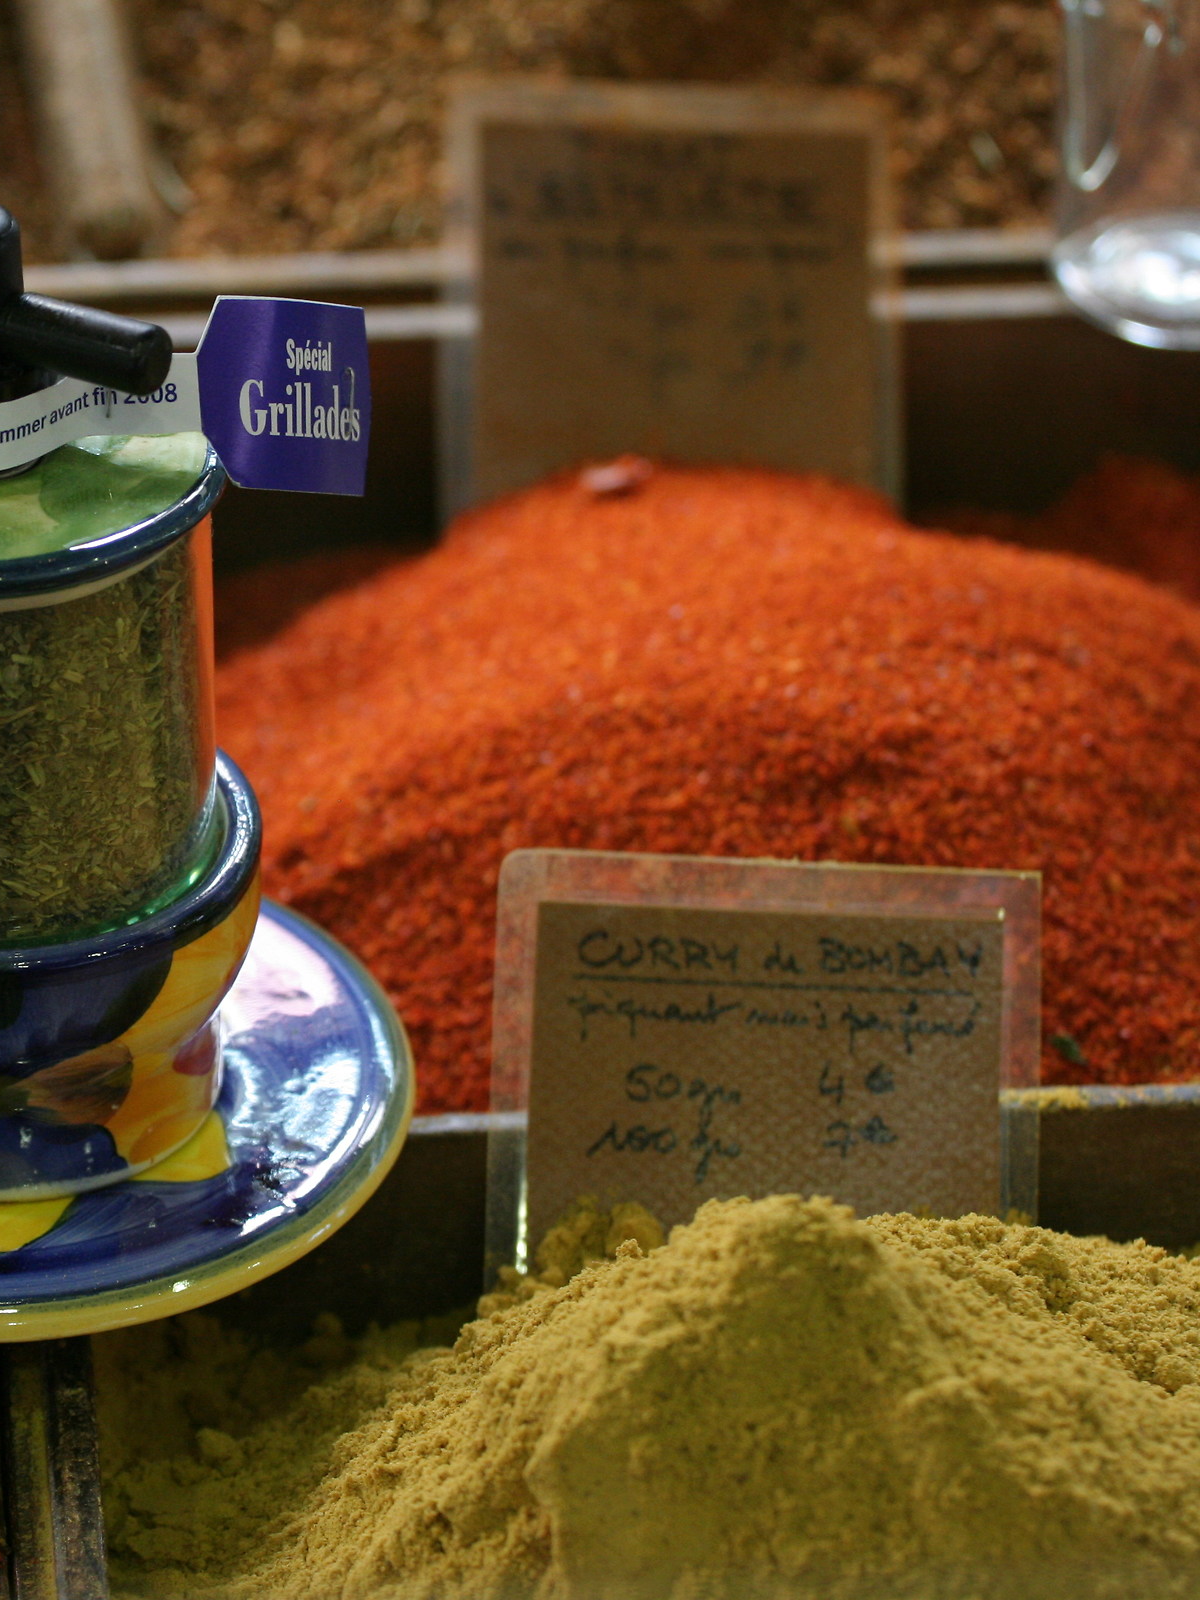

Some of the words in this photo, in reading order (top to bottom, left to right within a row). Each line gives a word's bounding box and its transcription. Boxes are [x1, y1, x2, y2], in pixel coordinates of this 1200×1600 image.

[285, 338, 332, 376] Spécial
[49, 391, 90, 425] avant
[92, 386, 118, 406] fin
[238, 379, 360, 442] Grillades
[577, 929, 739, 971] CURRY
[818, 936, 983, 978] BOMBAY
[625, 1062, 682, 1102] 50
